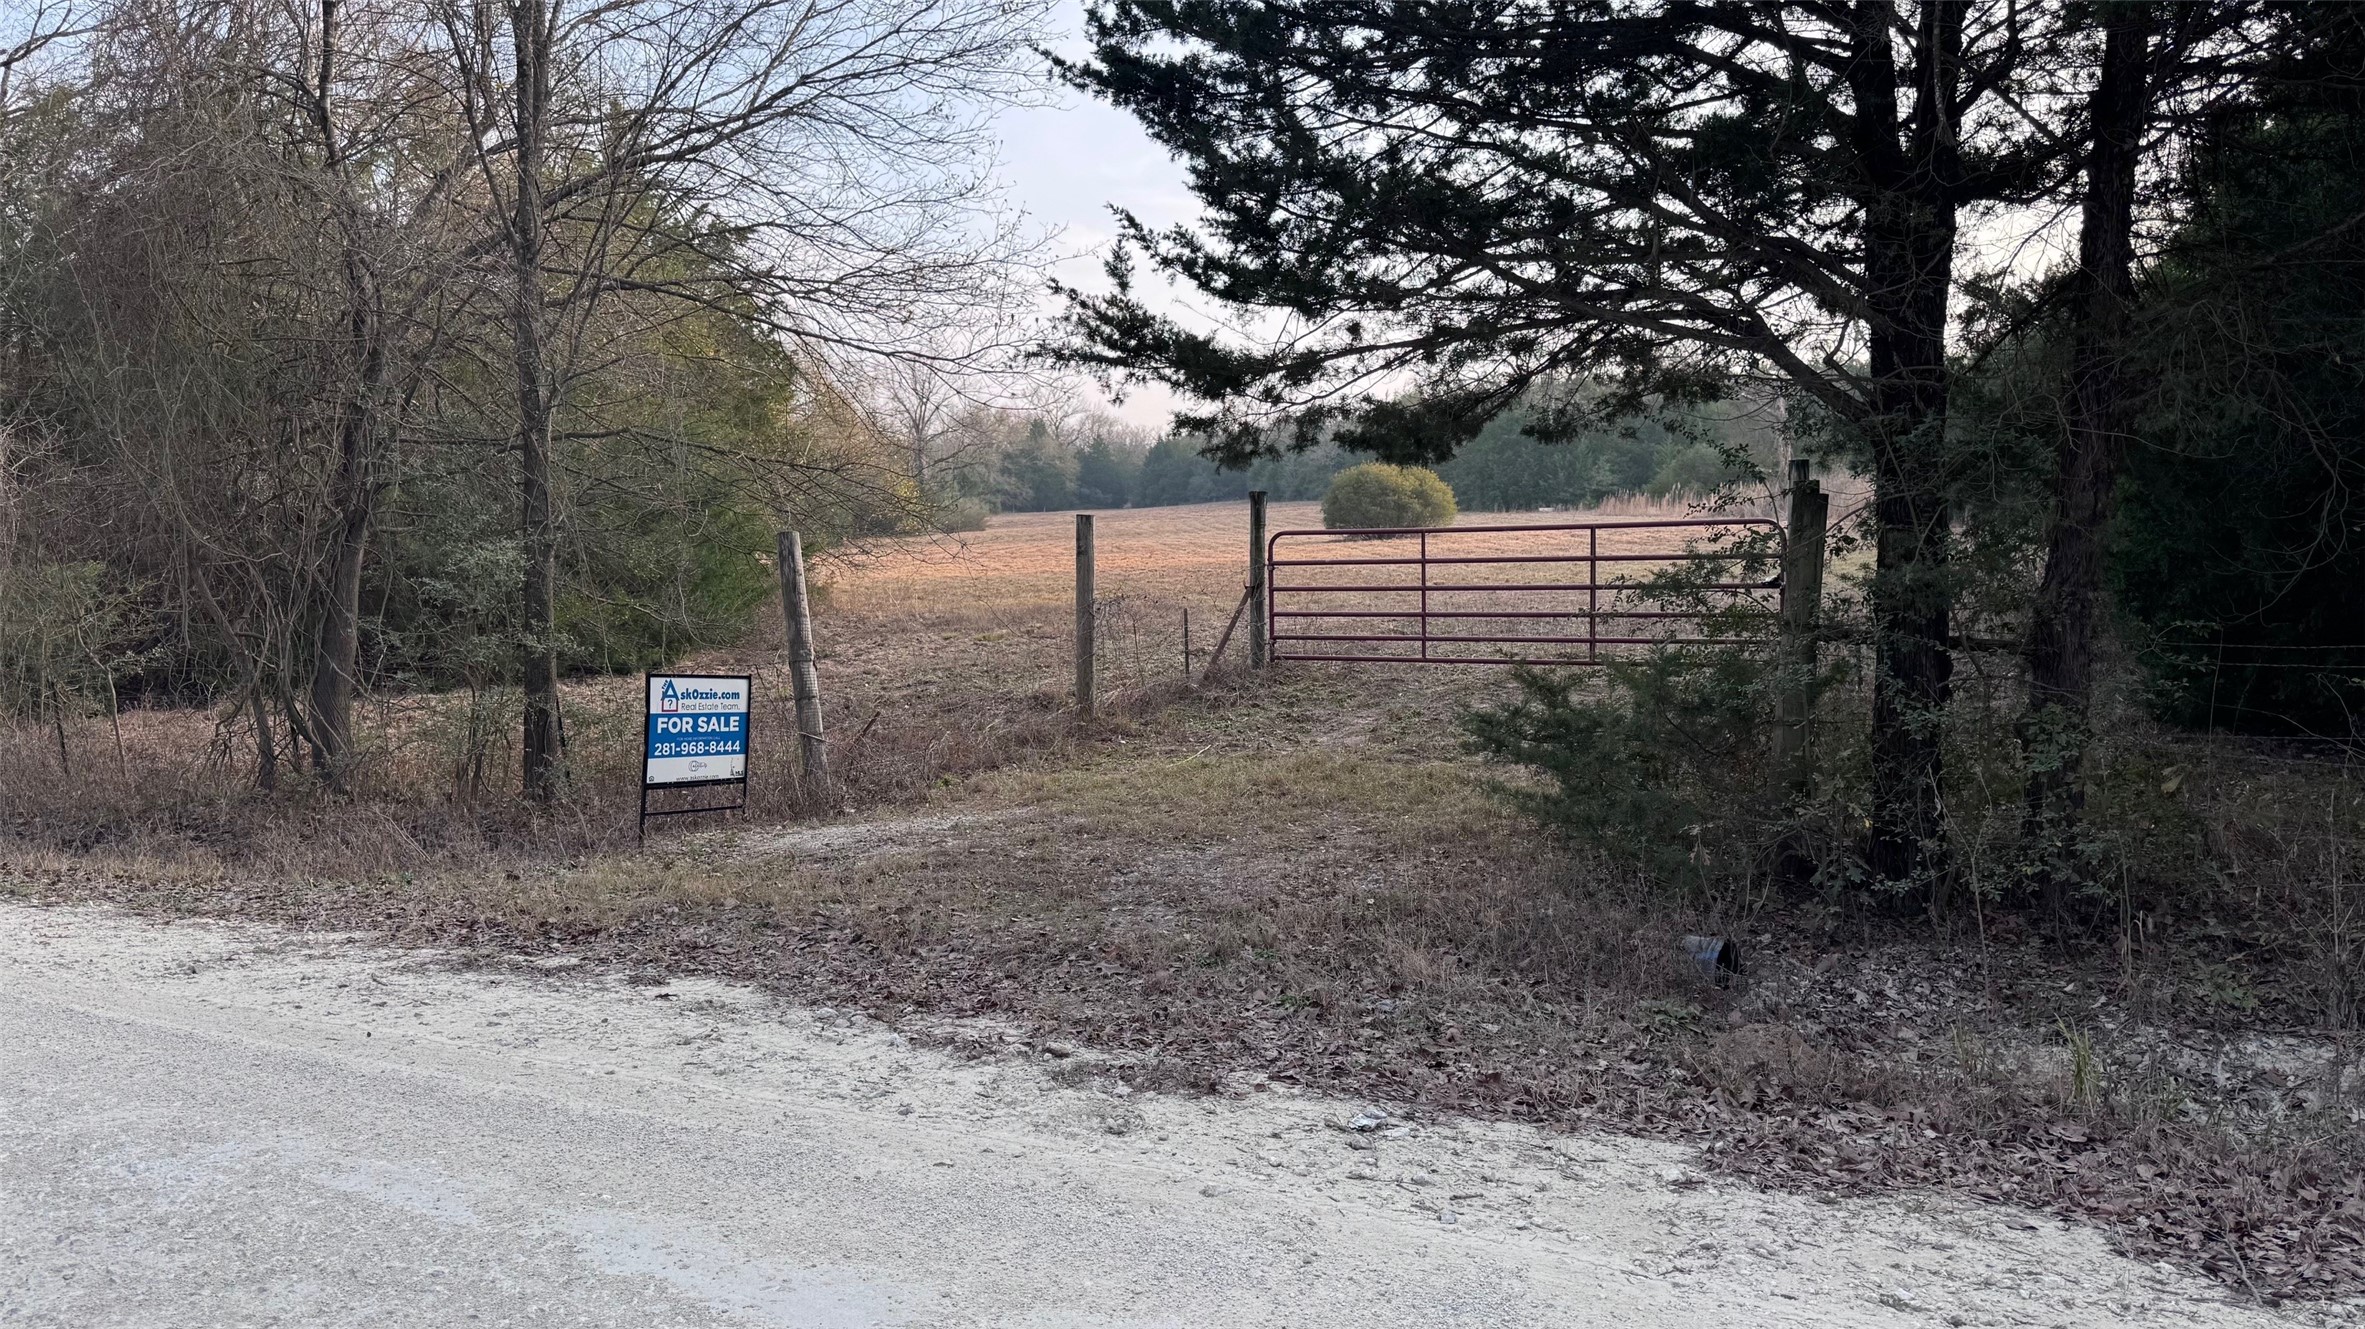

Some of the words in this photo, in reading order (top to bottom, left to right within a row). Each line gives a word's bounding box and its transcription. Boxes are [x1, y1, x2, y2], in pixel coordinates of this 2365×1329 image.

[681, 702, 697, 711] Real
[698, 702, 719, 711] Estate
[657, 717, 694, 734] FOR
[697, 716, 740, 733] SALE
[654, 740, 741, 756] 281-968-8444
